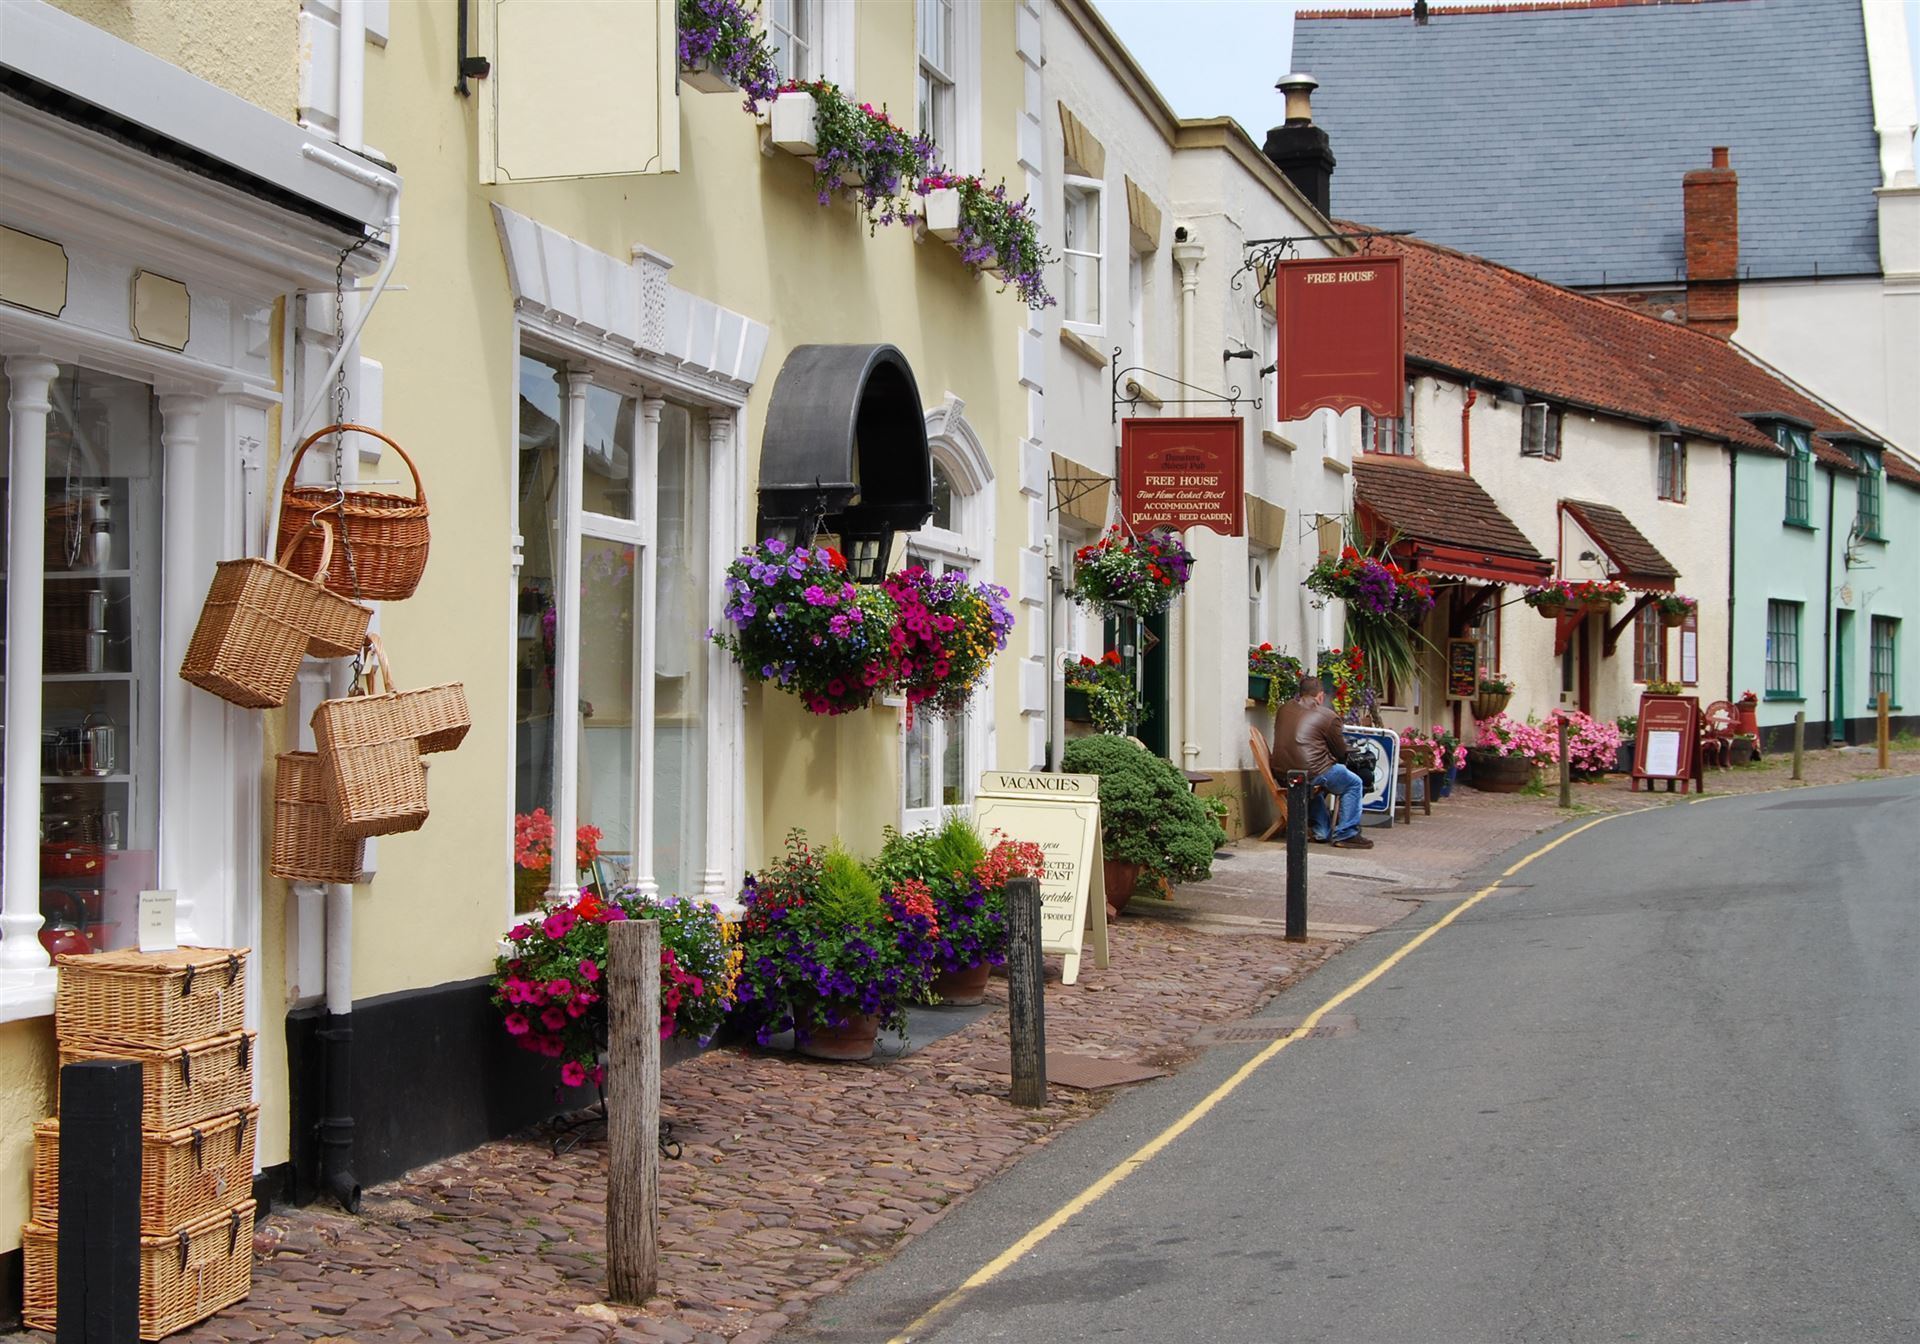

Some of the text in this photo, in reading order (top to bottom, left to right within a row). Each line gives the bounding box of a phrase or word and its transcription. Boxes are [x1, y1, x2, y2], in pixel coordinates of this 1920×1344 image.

[1307, 271, 1375, 284] FREE HOUSE
[1145, 476, 1218, 486] FREE HOUSE
[1137, 490, 1226, 499] Fine Home Cooked Food
[1144, 502, 1220, 510] ACCOMMODATION
[1132, 512, 1232, 525] REAL ALES BEER GARDEN
[1000, 776, 1080, 791] VACANCIES
[1042, 842, 1060, 850] you
[1043, 861, 1075, 870] ECTED
[1043, 912, 1073, 921] PRODUCE
